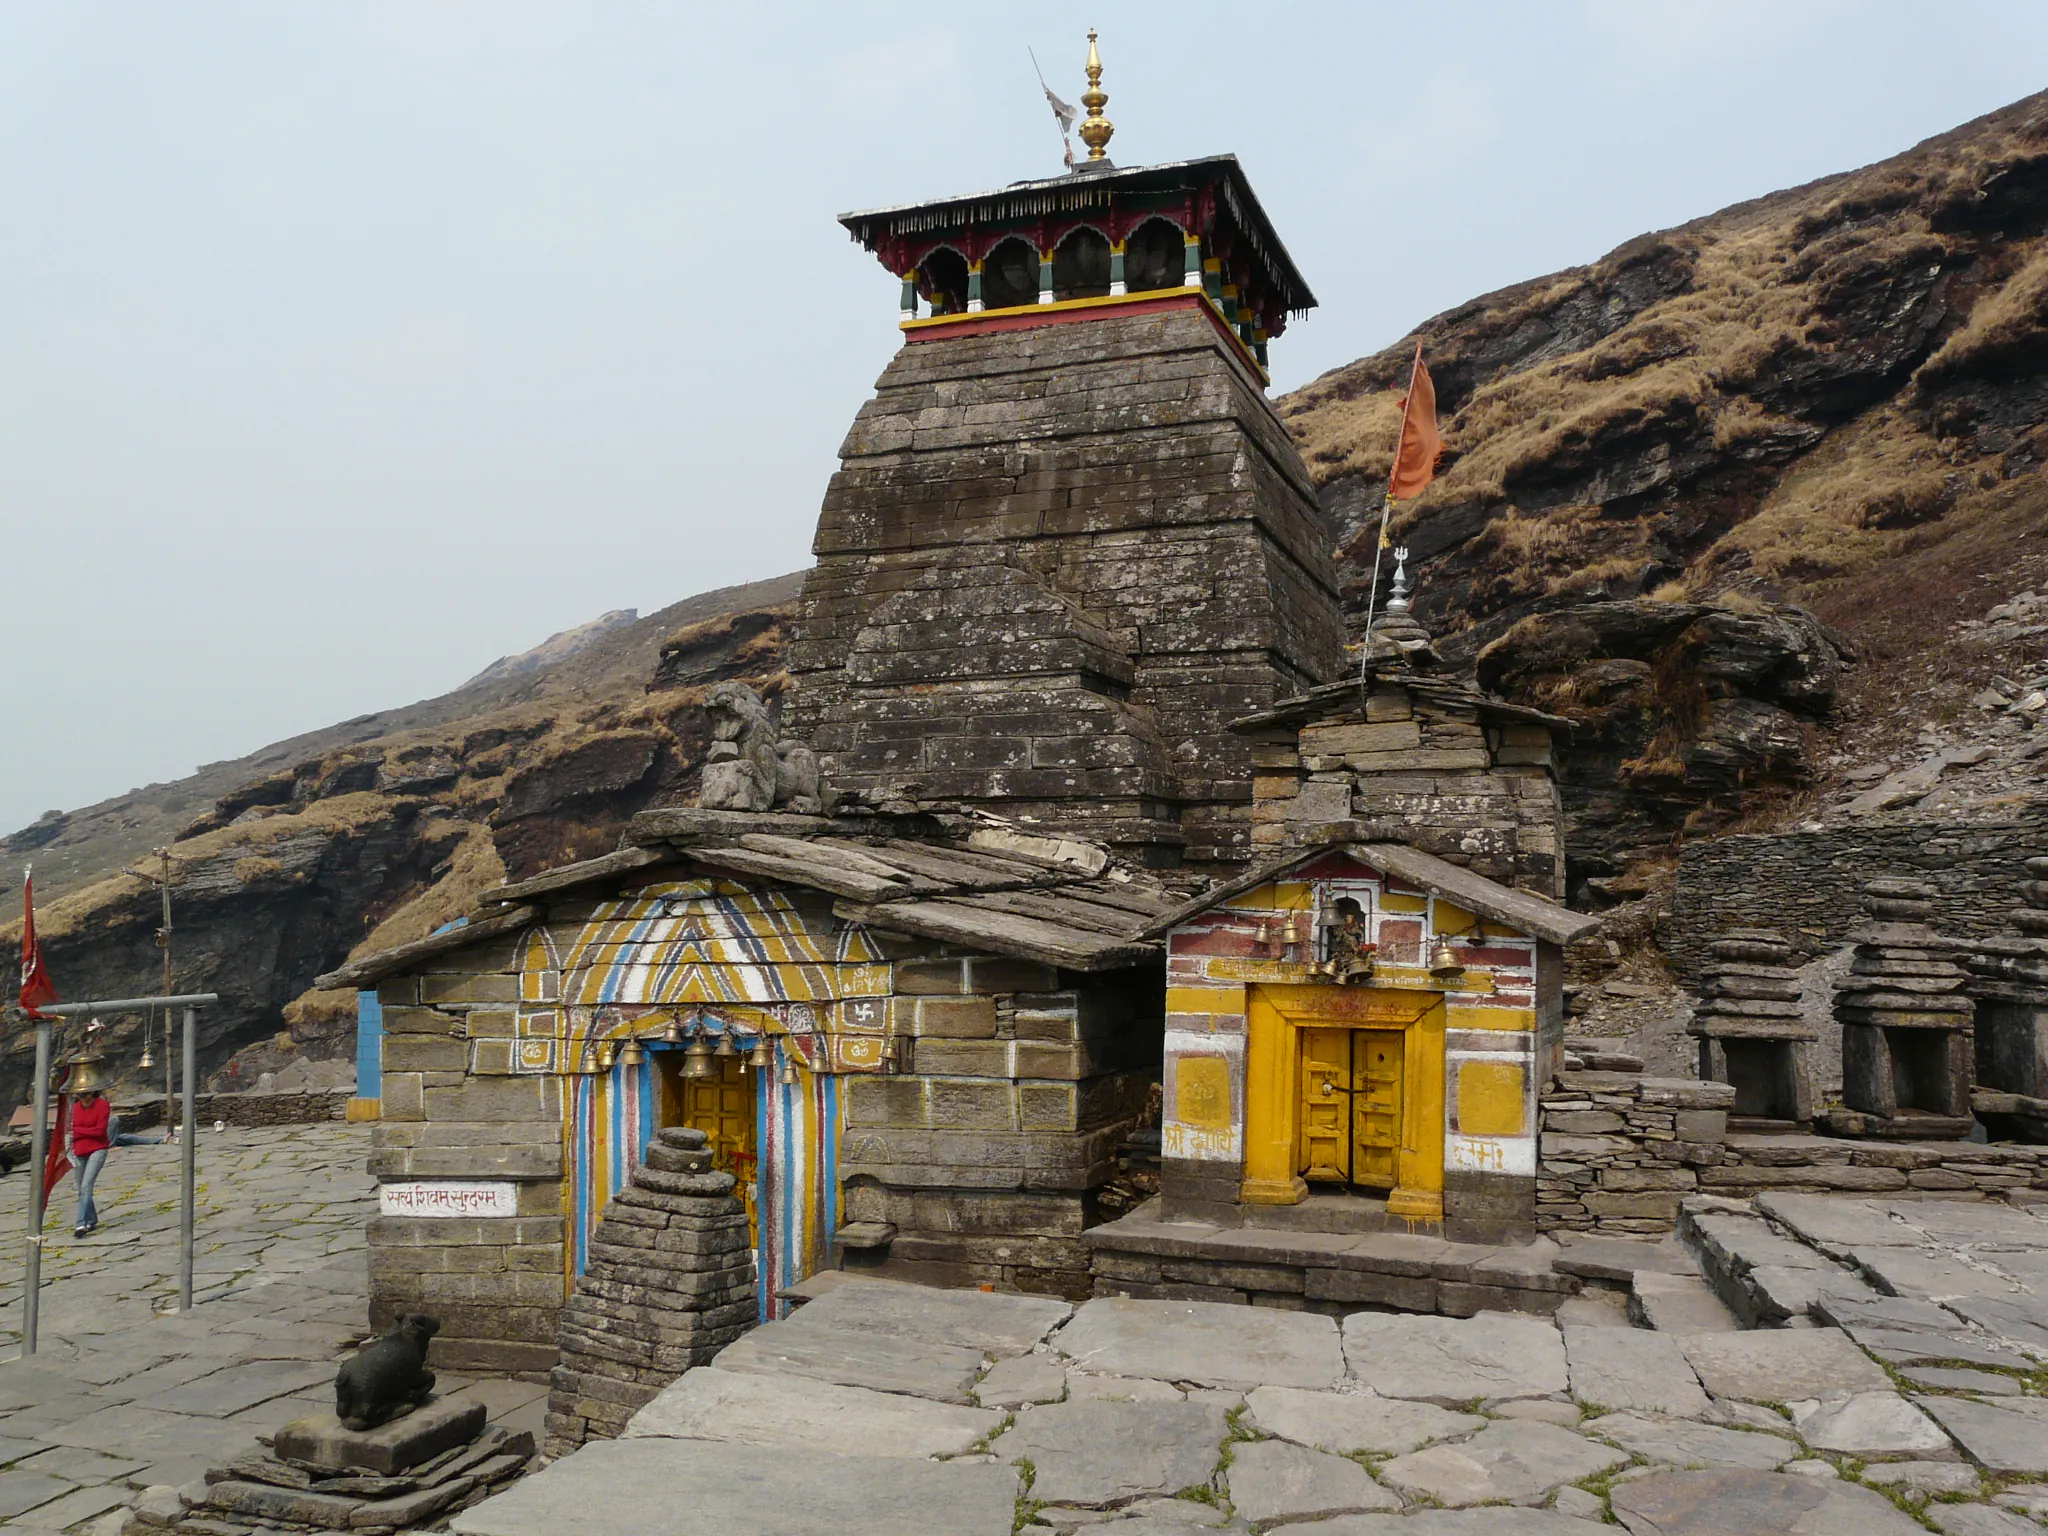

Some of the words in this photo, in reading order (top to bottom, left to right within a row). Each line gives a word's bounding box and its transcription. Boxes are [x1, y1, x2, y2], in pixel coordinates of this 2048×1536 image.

[386, 1186, 413, 1208] सत्यं
[415, 1185, 452, 1208] शिवम्
[450, 1190, 498, 1212] सुन्दरम्
